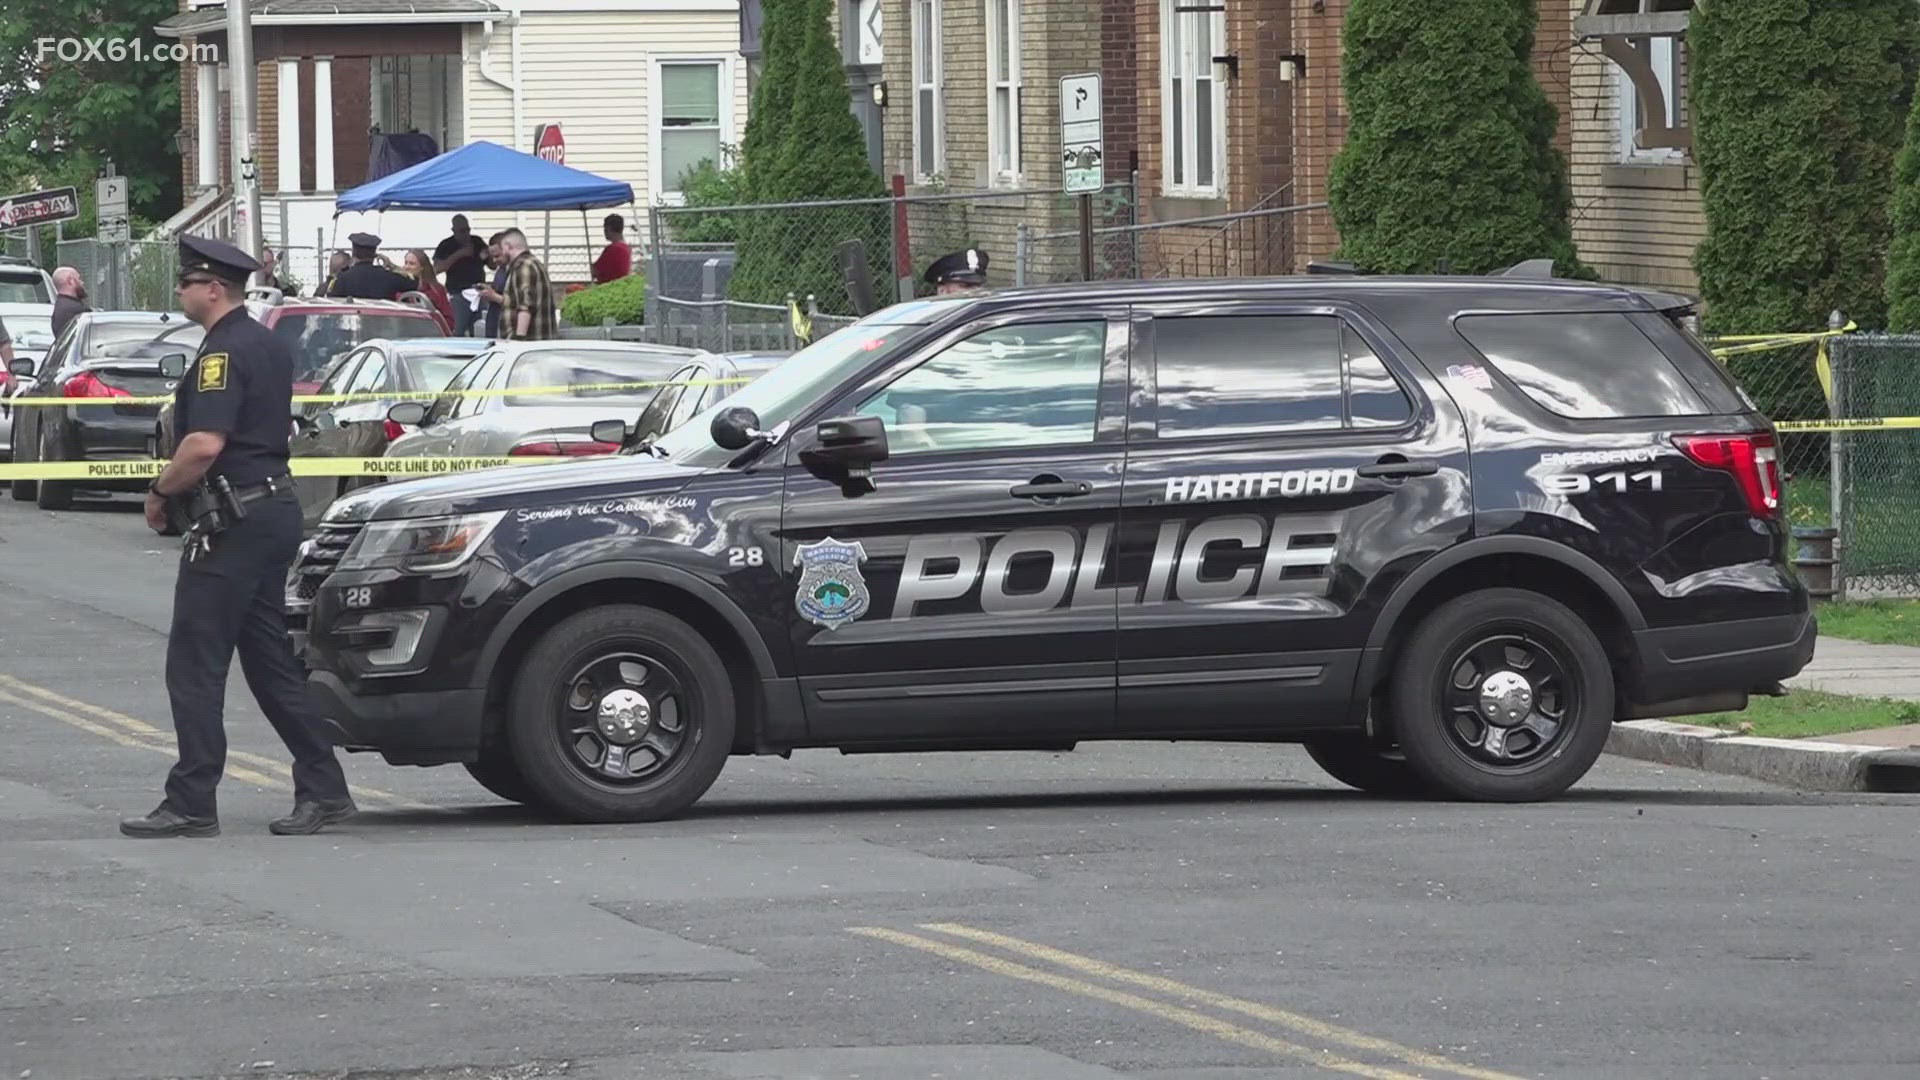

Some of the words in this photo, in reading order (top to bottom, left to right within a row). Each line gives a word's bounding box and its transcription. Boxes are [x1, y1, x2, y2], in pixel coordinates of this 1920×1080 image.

[12, 203, 35, 218] ONE
[363, 460, 402, 473] POLICE
[405, 460, 429, 473] LINE
[432, 460, 447, 473] DO
[450, 459, 472, 472] NOT
[1540, 448, 1659, 465] EMERGENCY
[89, 464, 126, 476] POLICE
[130, 464, 154, 475] LINE
[1164, 467, 1357, 503] HARTFORD
[1543, 470, 1662, 495] 911
[516, 507, 572, 522] Serving
[577, 502, 600, 516] the
[664, 495, 697, 511] City
[728, 546, 764, 567] 28
[891, 510, 1344, 622] POLICE
[346, 586, 372, 608] 28
